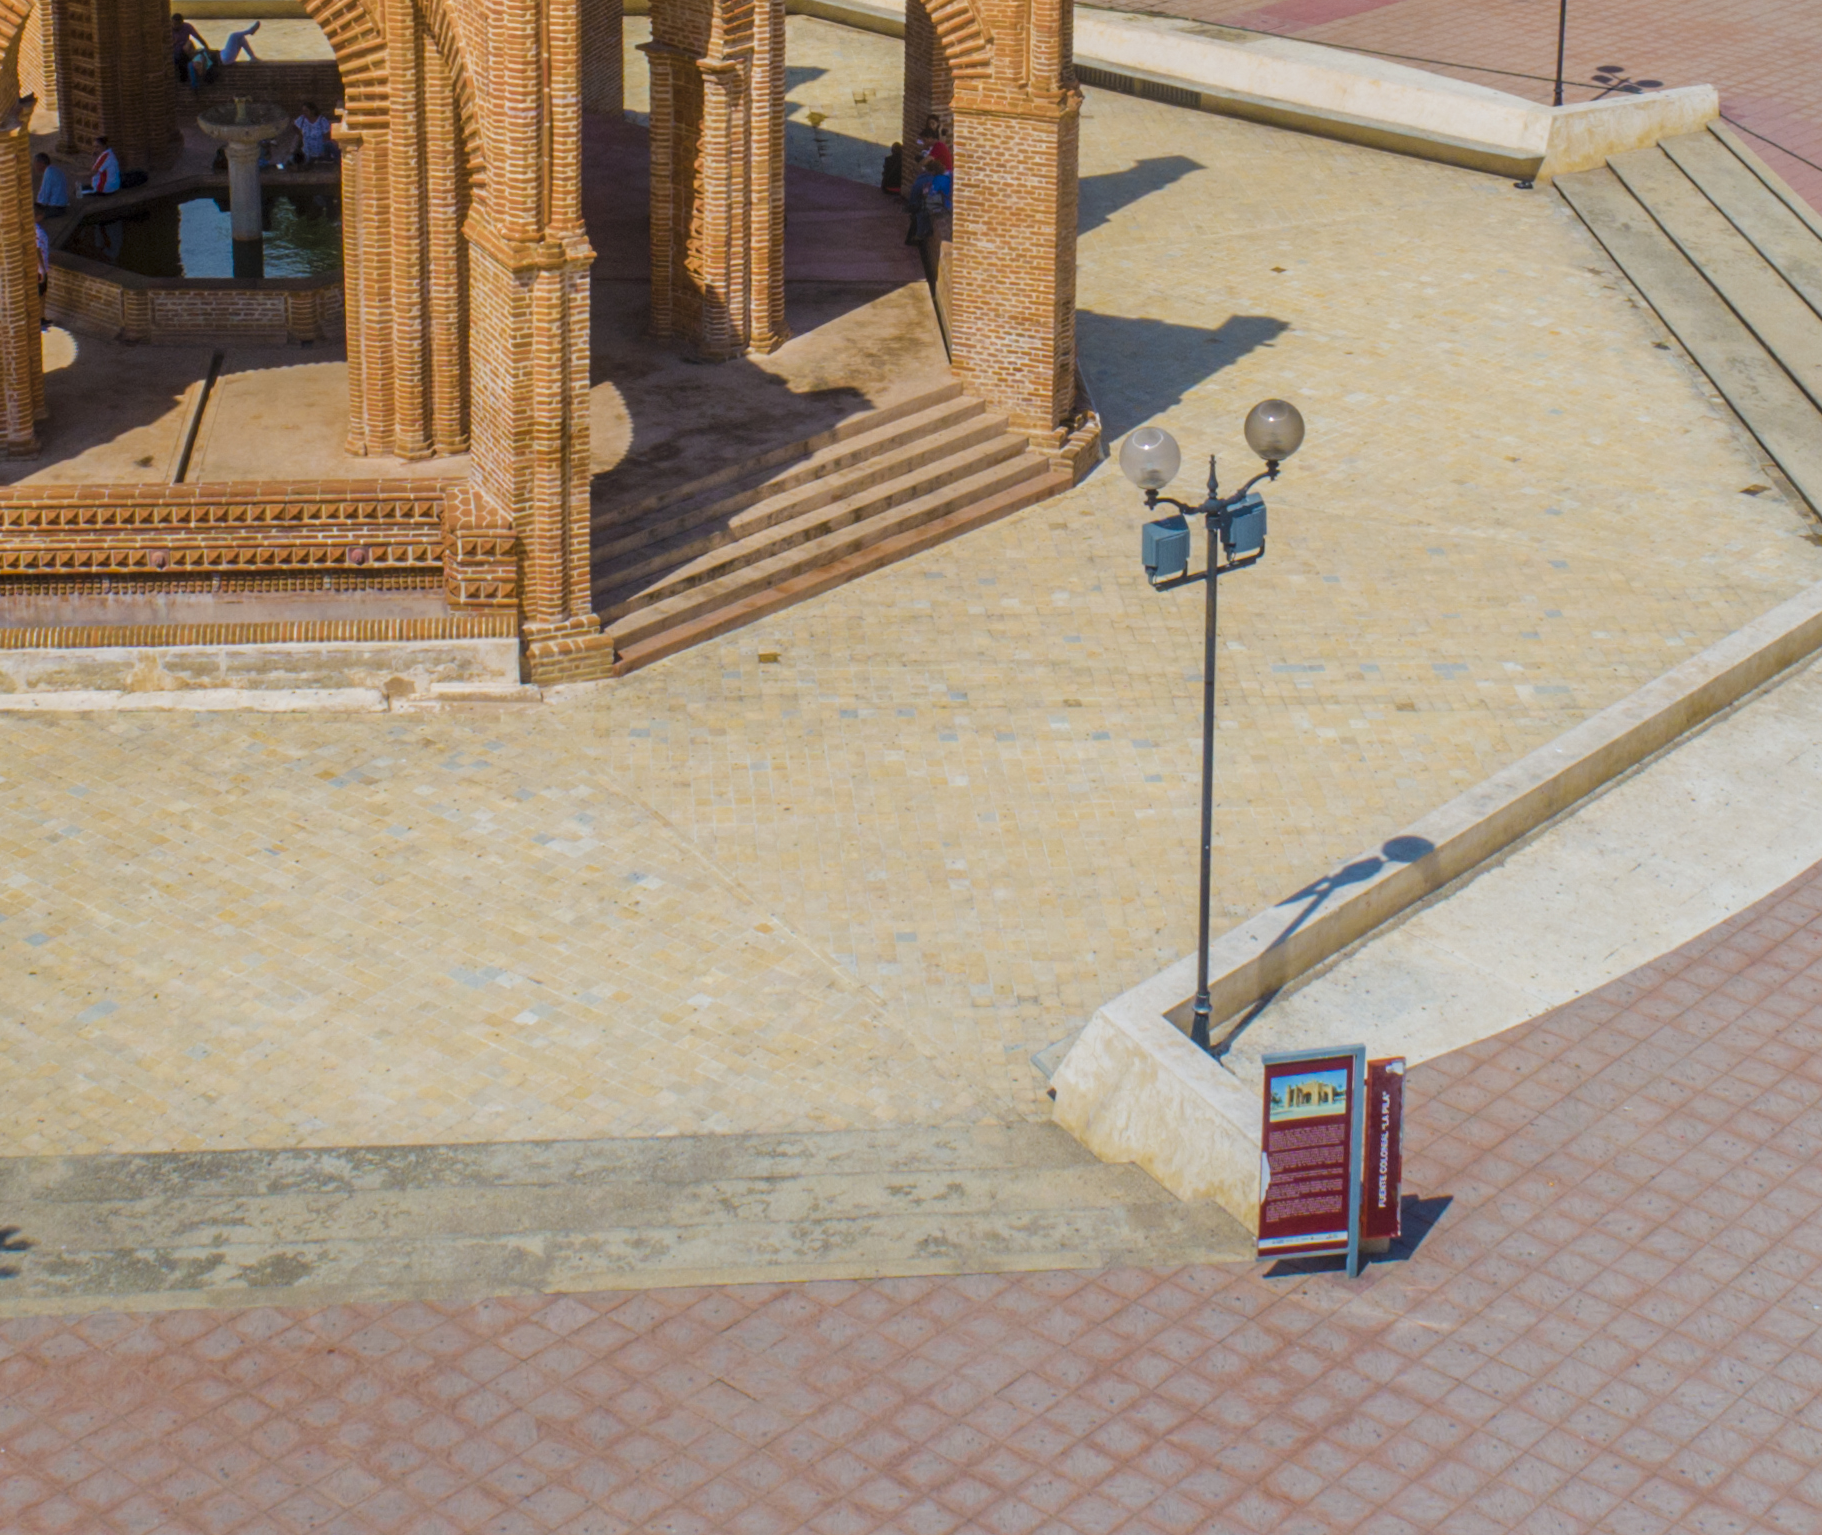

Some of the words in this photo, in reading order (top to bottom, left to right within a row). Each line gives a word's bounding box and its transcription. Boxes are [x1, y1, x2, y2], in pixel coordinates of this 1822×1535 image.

[1381, 1091, 1391, 1114] PILA"
[1381, 1115, 1390, 1130] "LA
[1379, 1131, 1389, 1174] COLONIAL
[1378, 1175, 1387, 1208] FUENTE
